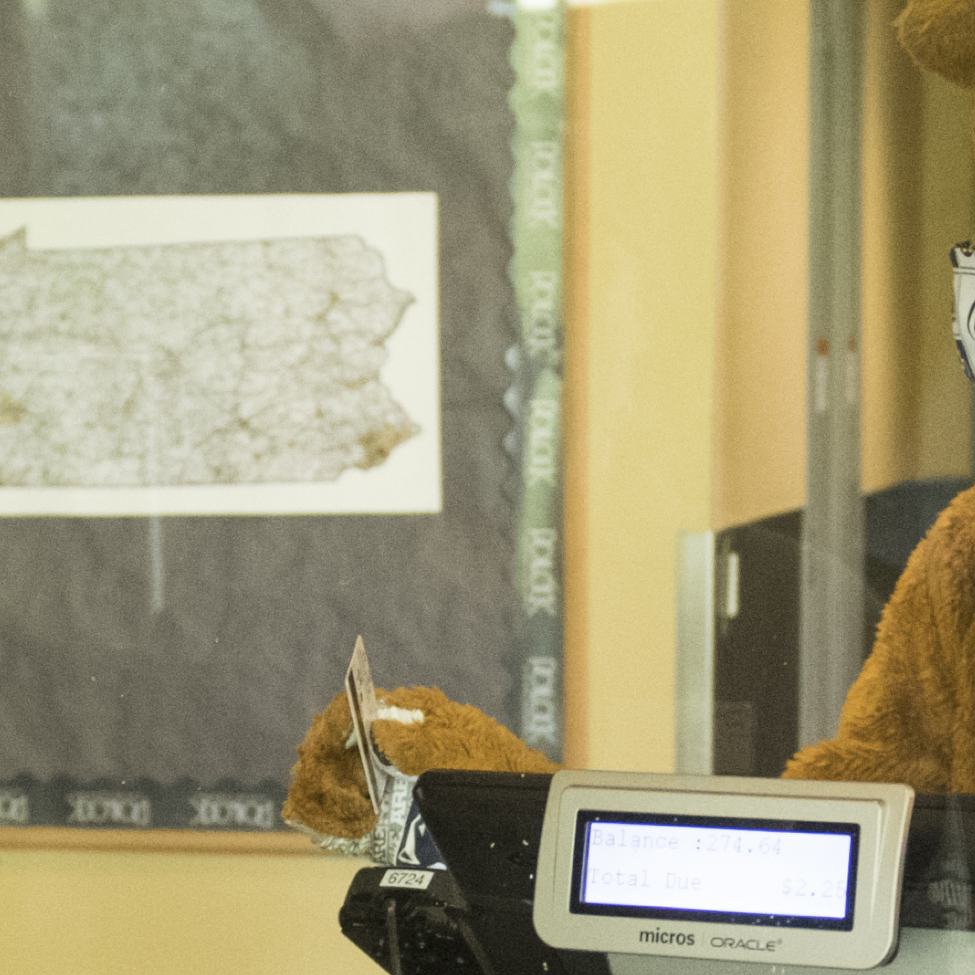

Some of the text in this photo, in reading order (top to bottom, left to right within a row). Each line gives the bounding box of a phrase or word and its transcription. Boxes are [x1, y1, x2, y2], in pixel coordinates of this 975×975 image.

[592, 829, 679, 850] Balance
[387, 872, 425, 885] 6724
[590, 868, 651, 888] Total
[666, 872, 702, 890] Due
[639, 926, 777, 952] micros ORACLE
